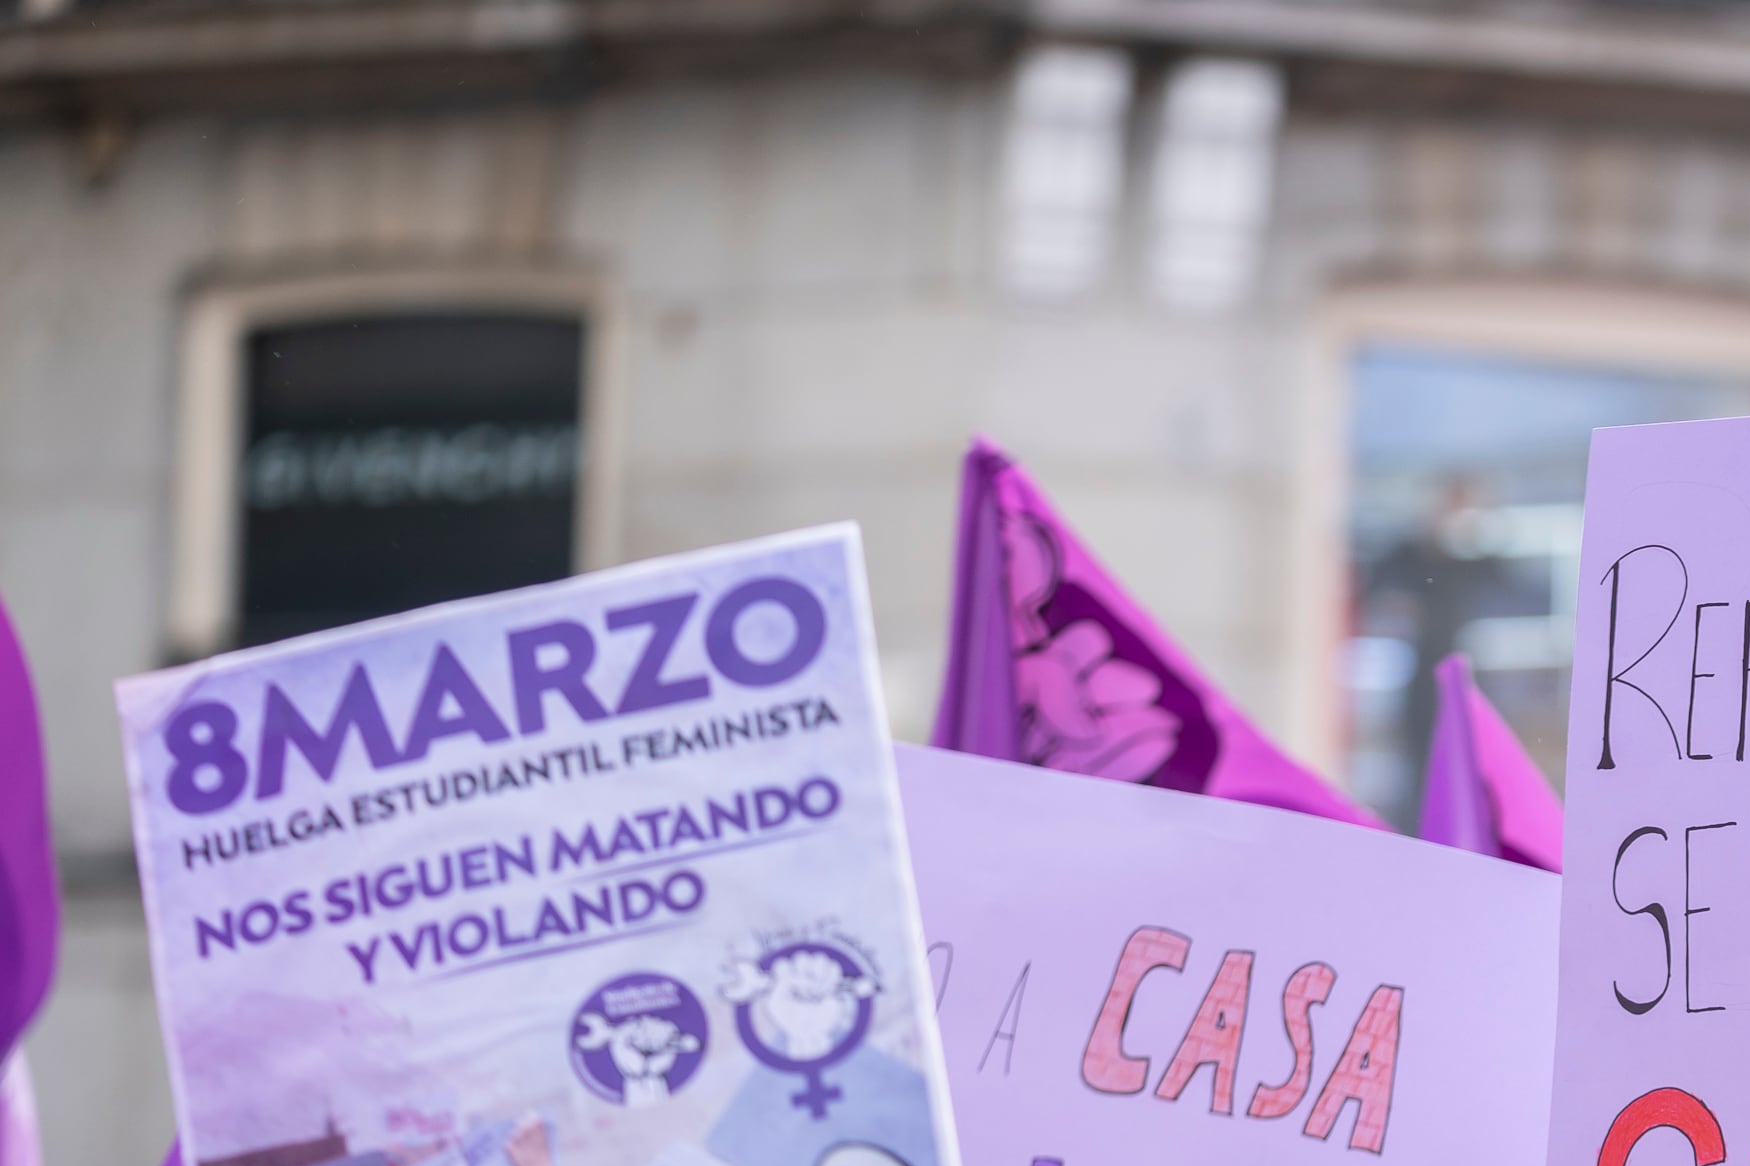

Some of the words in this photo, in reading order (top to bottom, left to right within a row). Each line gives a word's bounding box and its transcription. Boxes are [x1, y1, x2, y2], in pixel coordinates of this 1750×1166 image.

[164, 576, 827, 815] 8MARZO
[183, 808, 344, 869] HUELGA
[353, 750, 616, 826] ESTUDIANTIL
[622, 697, 841, 773] FEMINISTA
[194, 891, 313, 957] NOS
[324, 836, 534, 923] SIGUEN
[548, 776, 843, 875] MATANDO
[346, 940, 382, 984] Y
[390, 869, 706, 968] VIOLANDO
[1610, 819, 1738, 1017] SE
[976, 959, 1032, 1076] A
[1079, 925, 1406, 1155] CASA
